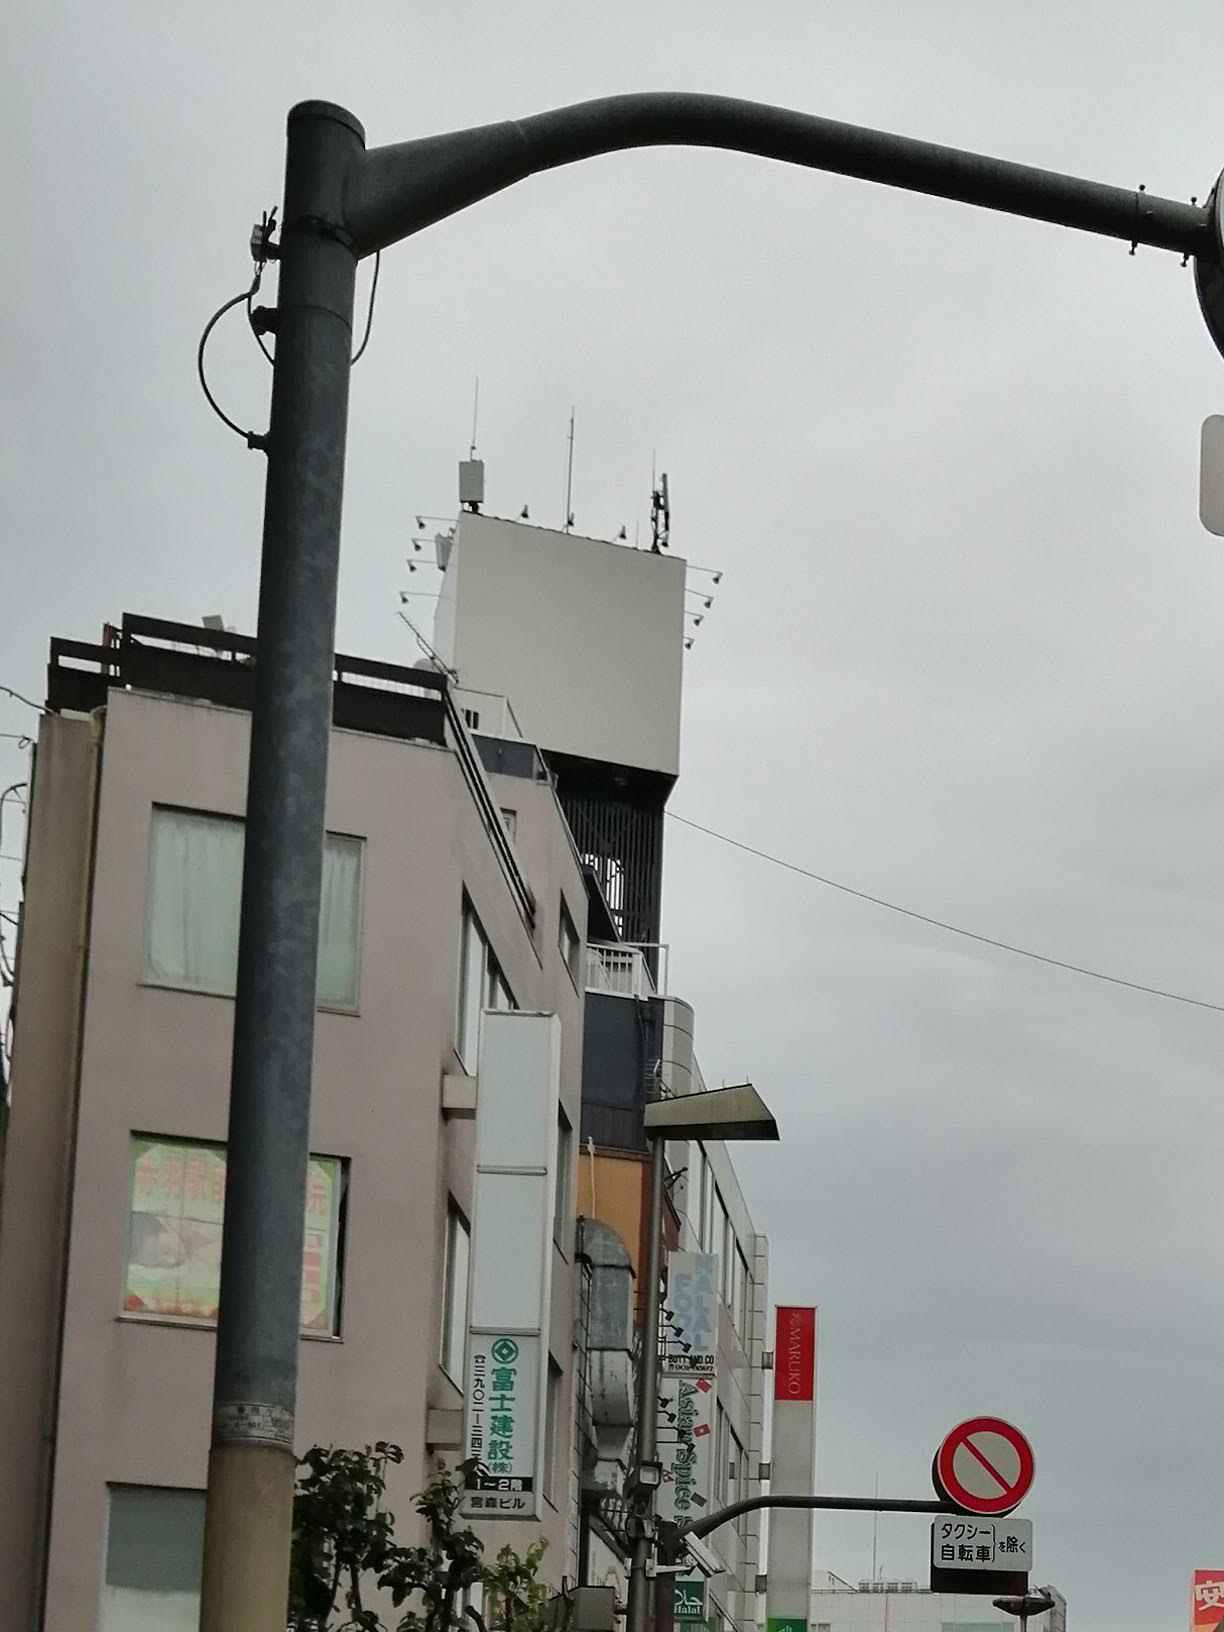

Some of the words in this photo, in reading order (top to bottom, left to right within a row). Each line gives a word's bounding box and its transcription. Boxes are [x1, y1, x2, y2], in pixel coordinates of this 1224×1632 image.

[788, 1327, 801, 1395] MARUKO
[941, 1523, 991, 1540] タクシー
[941, 1544, 991, 1563] 自転車
[998, 1536, 1027, 1554] を除く
